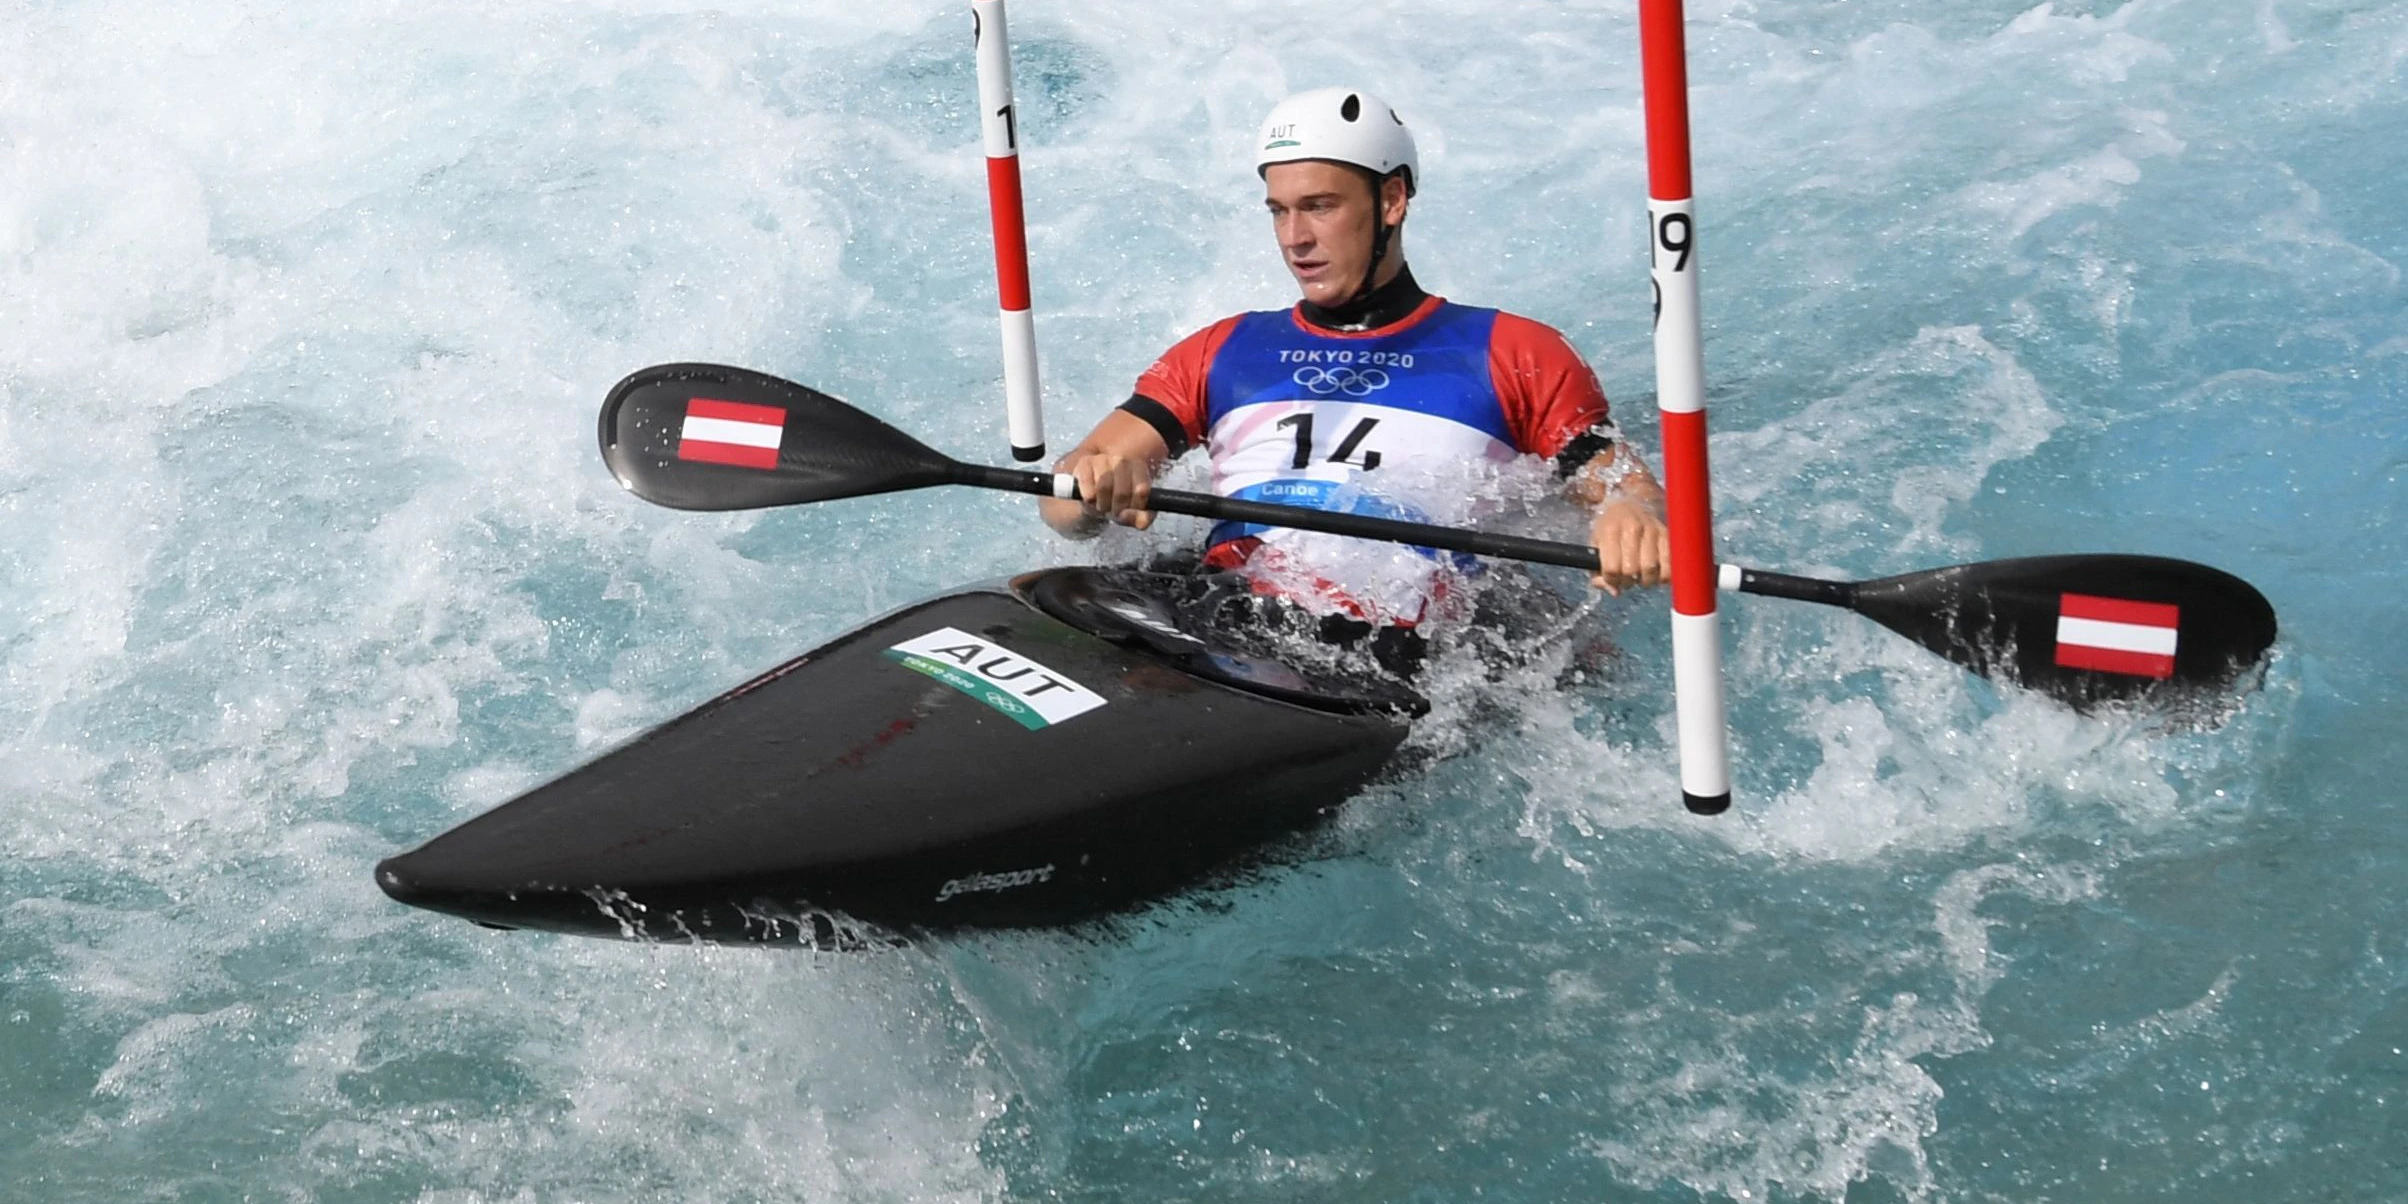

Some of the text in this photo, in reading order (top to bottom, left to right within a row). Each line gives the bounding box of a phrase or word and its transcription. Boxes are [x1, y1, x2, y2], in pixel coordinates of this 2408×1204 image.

[996, 104, 1017, 149] 1
[1270, 124, 1296, 138] AUT
[1279, 350, 1414, 369] TOKYO 2020
[1276, 412, 1382, 472] 14
[1261, 482, 1319, 496] Canoe
[928, 643, 1076, 697] AUT
